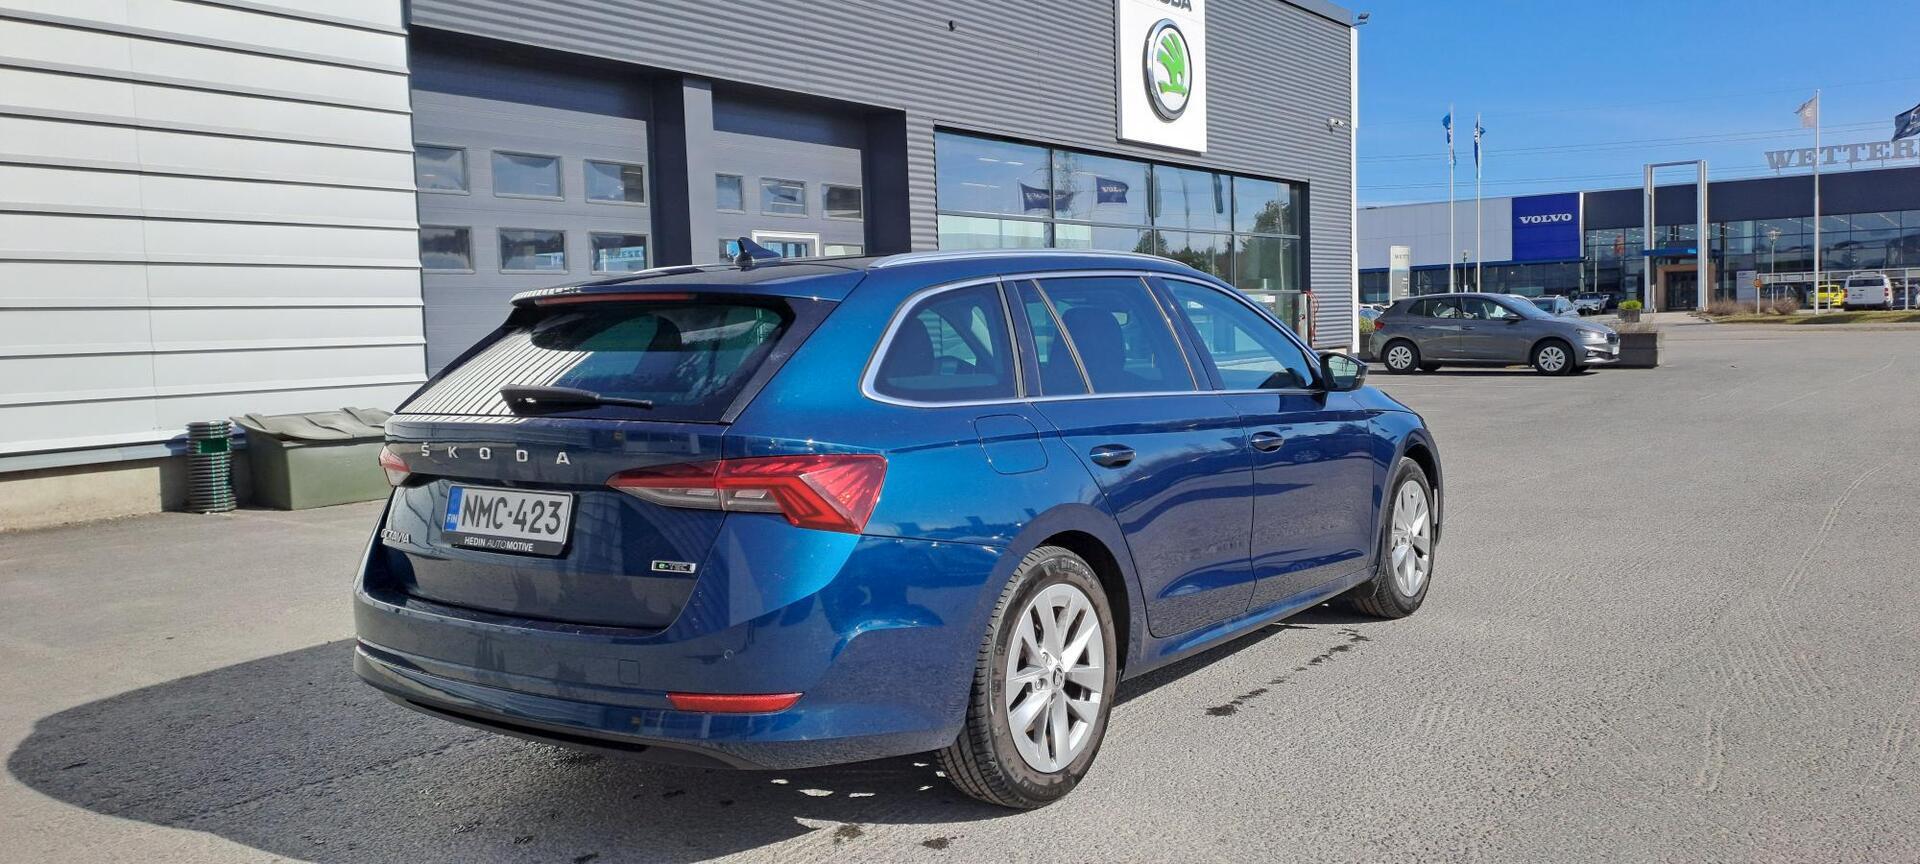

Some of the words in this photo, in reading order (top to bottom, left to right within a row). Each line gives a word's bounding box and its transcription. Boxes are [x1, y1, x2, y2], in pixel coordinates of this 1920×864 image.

[1764, 139, 1920, 169] WETTER
[1519, 213, 1572, 224] VOLVO
[421, 442, 571, 465] ŠKODA
[446, 513, 459, 524] FIN
[462, 494, 563, 535] NMC-423
[464, 536, 486, 547] HEDIN
[487, 539, 534, 552] AUTOMOTIVE
